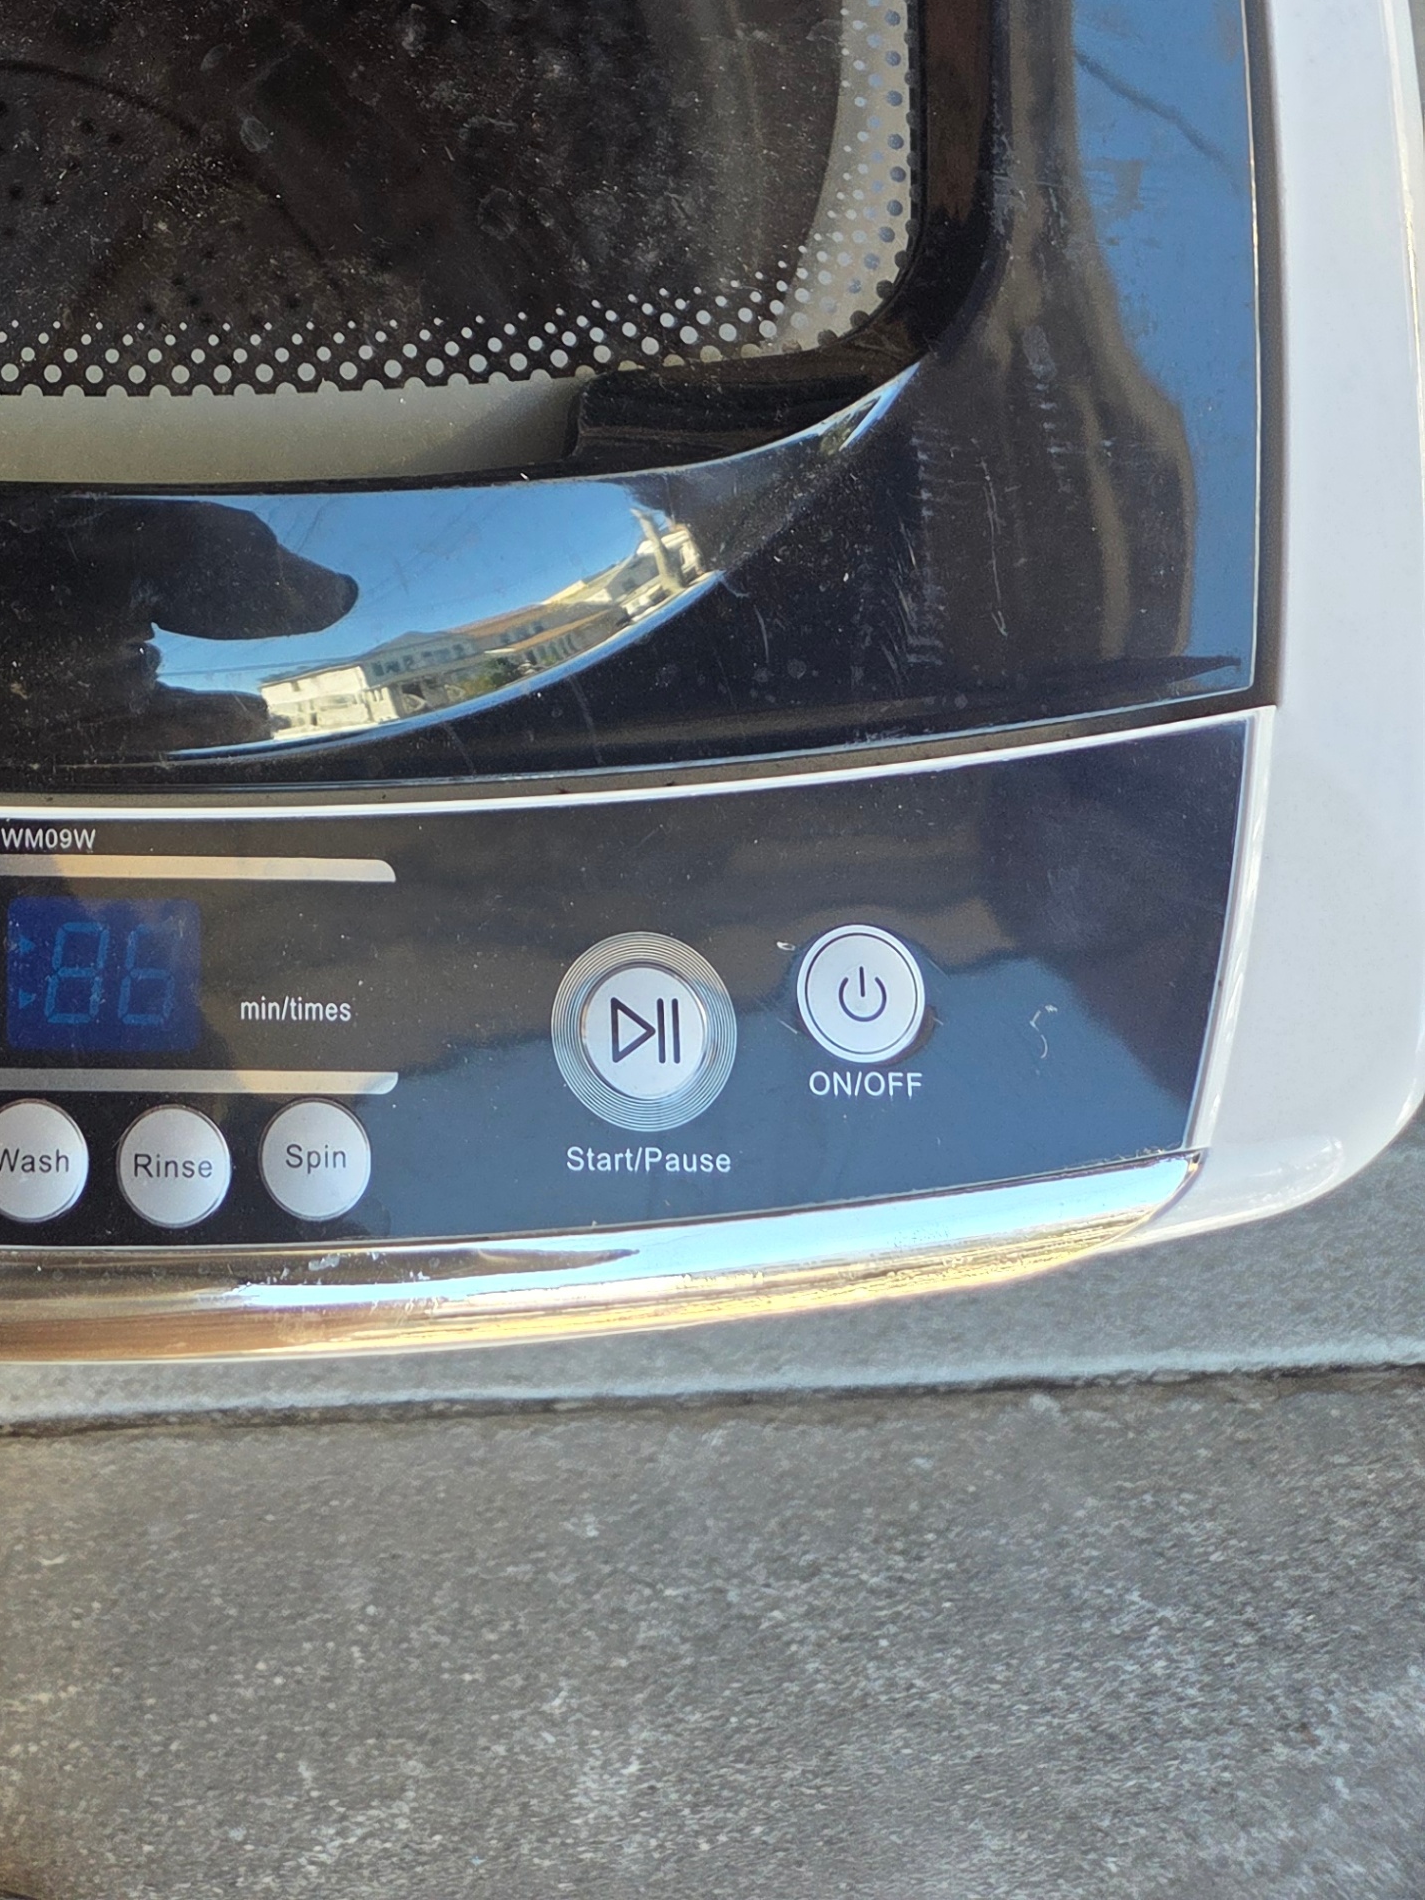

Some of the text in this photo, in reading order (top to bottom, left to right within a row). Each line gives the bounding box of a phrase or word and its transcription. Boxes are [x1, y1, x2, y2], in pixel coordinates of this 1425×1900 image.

[240, 996, 352, 1022] min/times
[809, 1070, 923, 1097] ON/OFF
[133, 1152, 213, 1179] Rinse
[284, 1143, 348, 1175] Spin
[566, 1146, 732, 1173] Start/Pause
